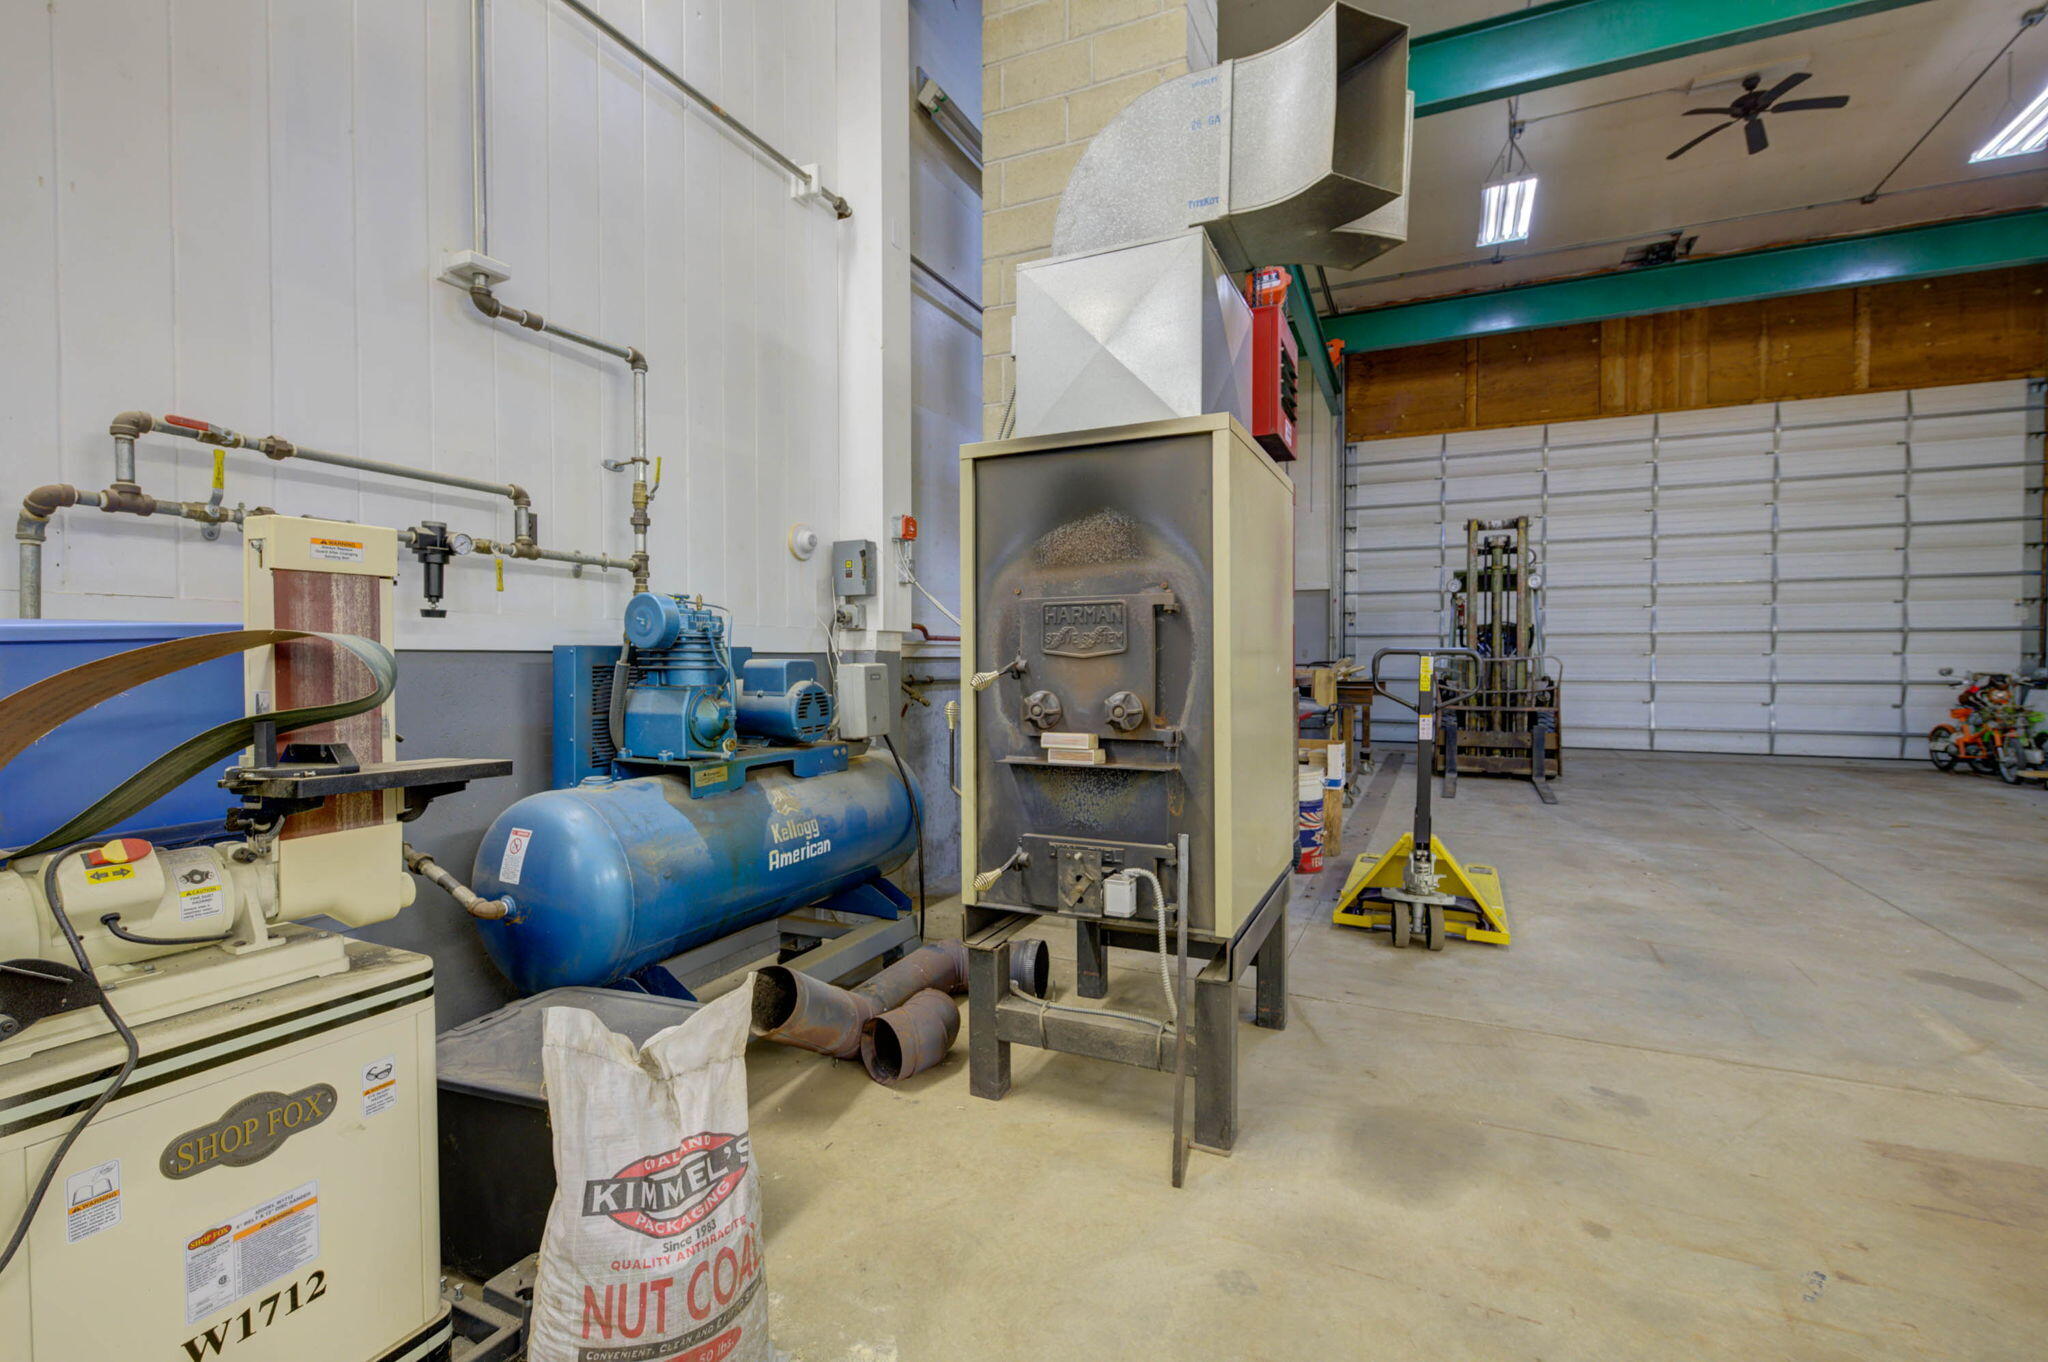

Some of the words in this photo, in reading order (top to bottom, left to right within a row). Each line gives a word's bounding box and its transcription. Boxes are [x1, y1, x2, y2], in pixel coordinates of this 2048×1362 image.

[1044, 605, 1123, 625] HARMAN
[770, 818, 820, 844] Kellogg
[768, 838, 831, 872] American
[177, 1117, 259, 1173] SHOP
[267, 1093, 324, 1136] FOX
[82, 1190, 118, 1209] WARNING
[635, 1180, 731, 1234] PACKAGING
[190, 1232, 212, 1249] SHOP
[213, 1226, 229, 1237] FOX
[663, 1236, 692, 1253] Since
[696, 1219, 717, 1239] 1983
[610, 1255, 671, 1272] QUALITY
[180, 1270, 327, 1362] W1712
[582, 1277, 674, 1340] NUT
